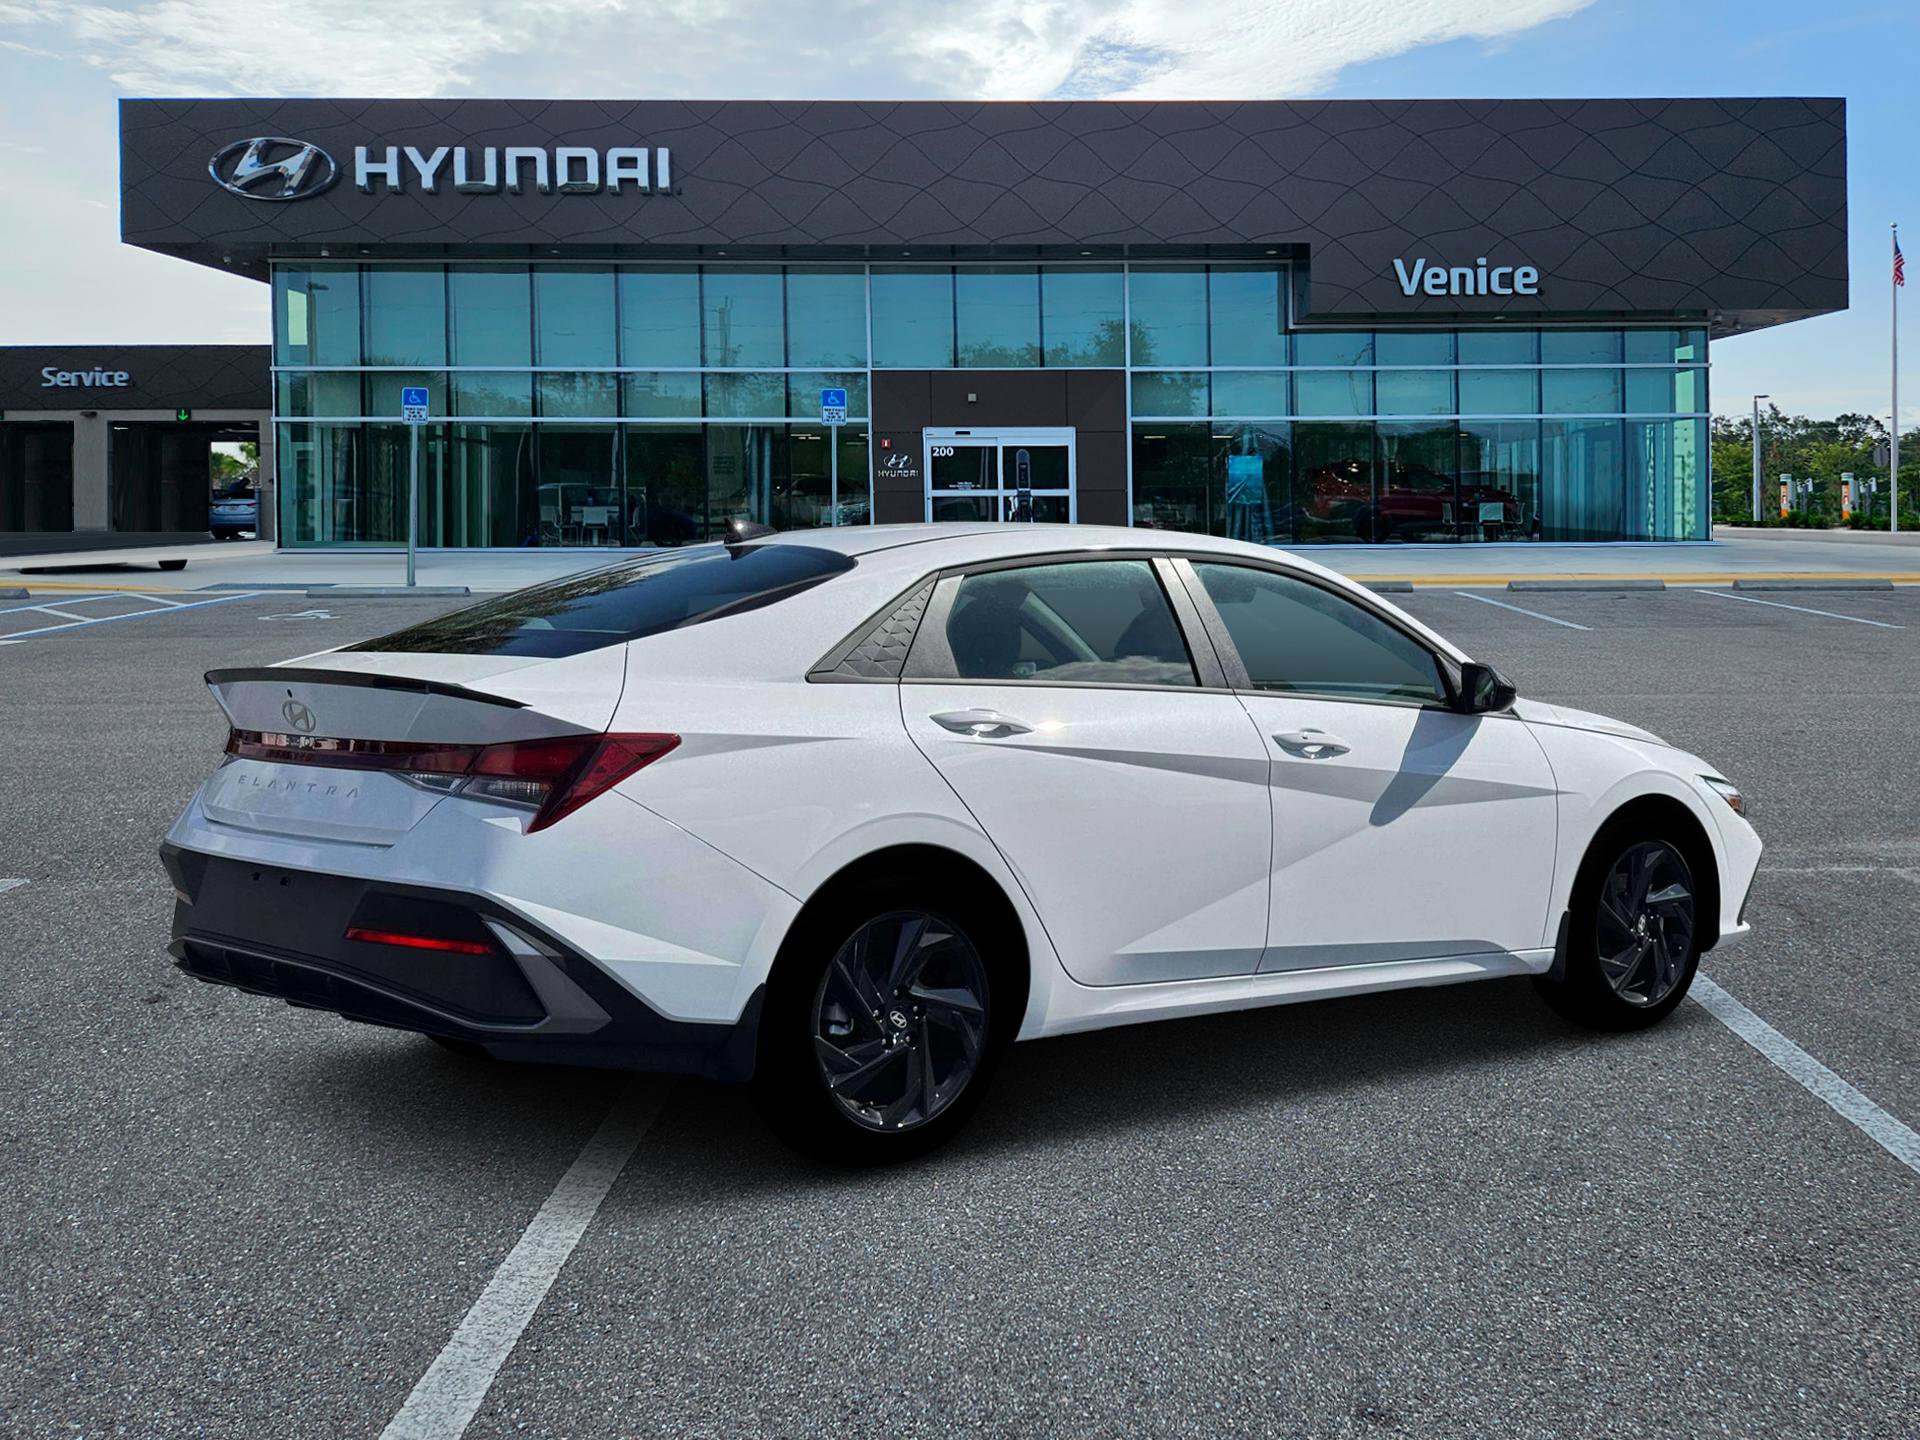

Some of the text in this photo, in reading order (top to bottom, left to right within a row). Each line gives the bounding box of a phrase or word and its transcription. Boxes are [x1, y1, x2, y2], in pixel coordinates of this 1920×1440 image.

[355, 146, 671, 193] HYUNDAI
[1393, 257, 1539, 295] Venice
[41, 366, 130, 387] Service
[932, 447, 954, 457] 200
[238, 775, 359, 798] ELANTRA
